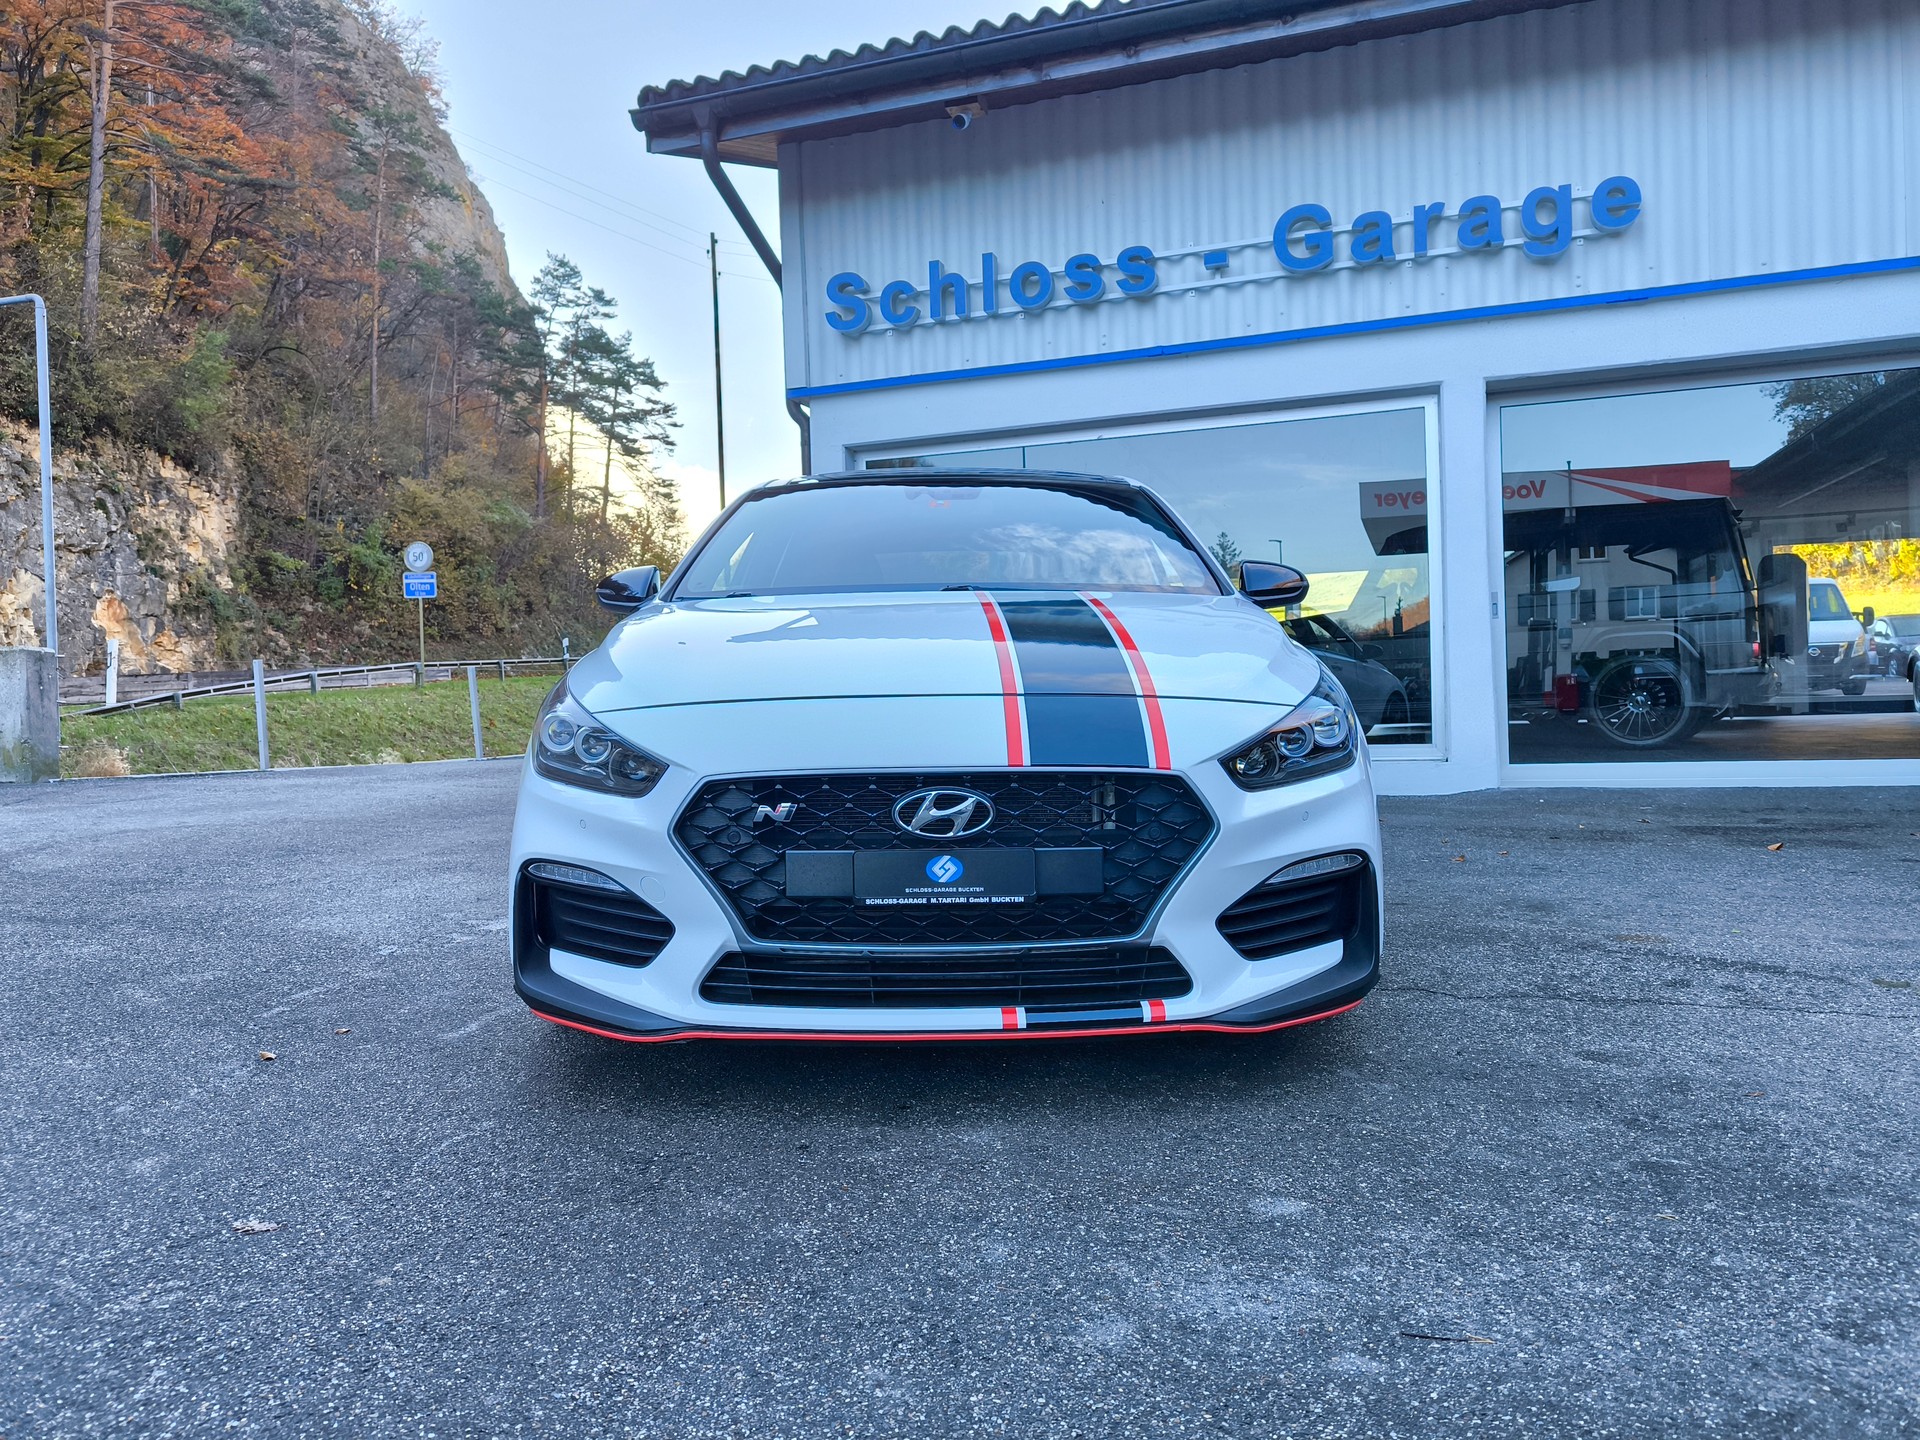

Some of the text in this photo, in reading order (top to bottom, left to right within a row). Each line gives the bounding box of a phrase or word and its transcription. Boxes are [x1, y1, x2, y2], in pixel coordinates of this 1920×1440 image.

[824, 175, 1643, 336] Schloss - Garage
[413, 552, 424, 562] 50
[410, 582, 431, 591] Olten
[865, 897, 927, 905] SCHLOSS-GARAGE
